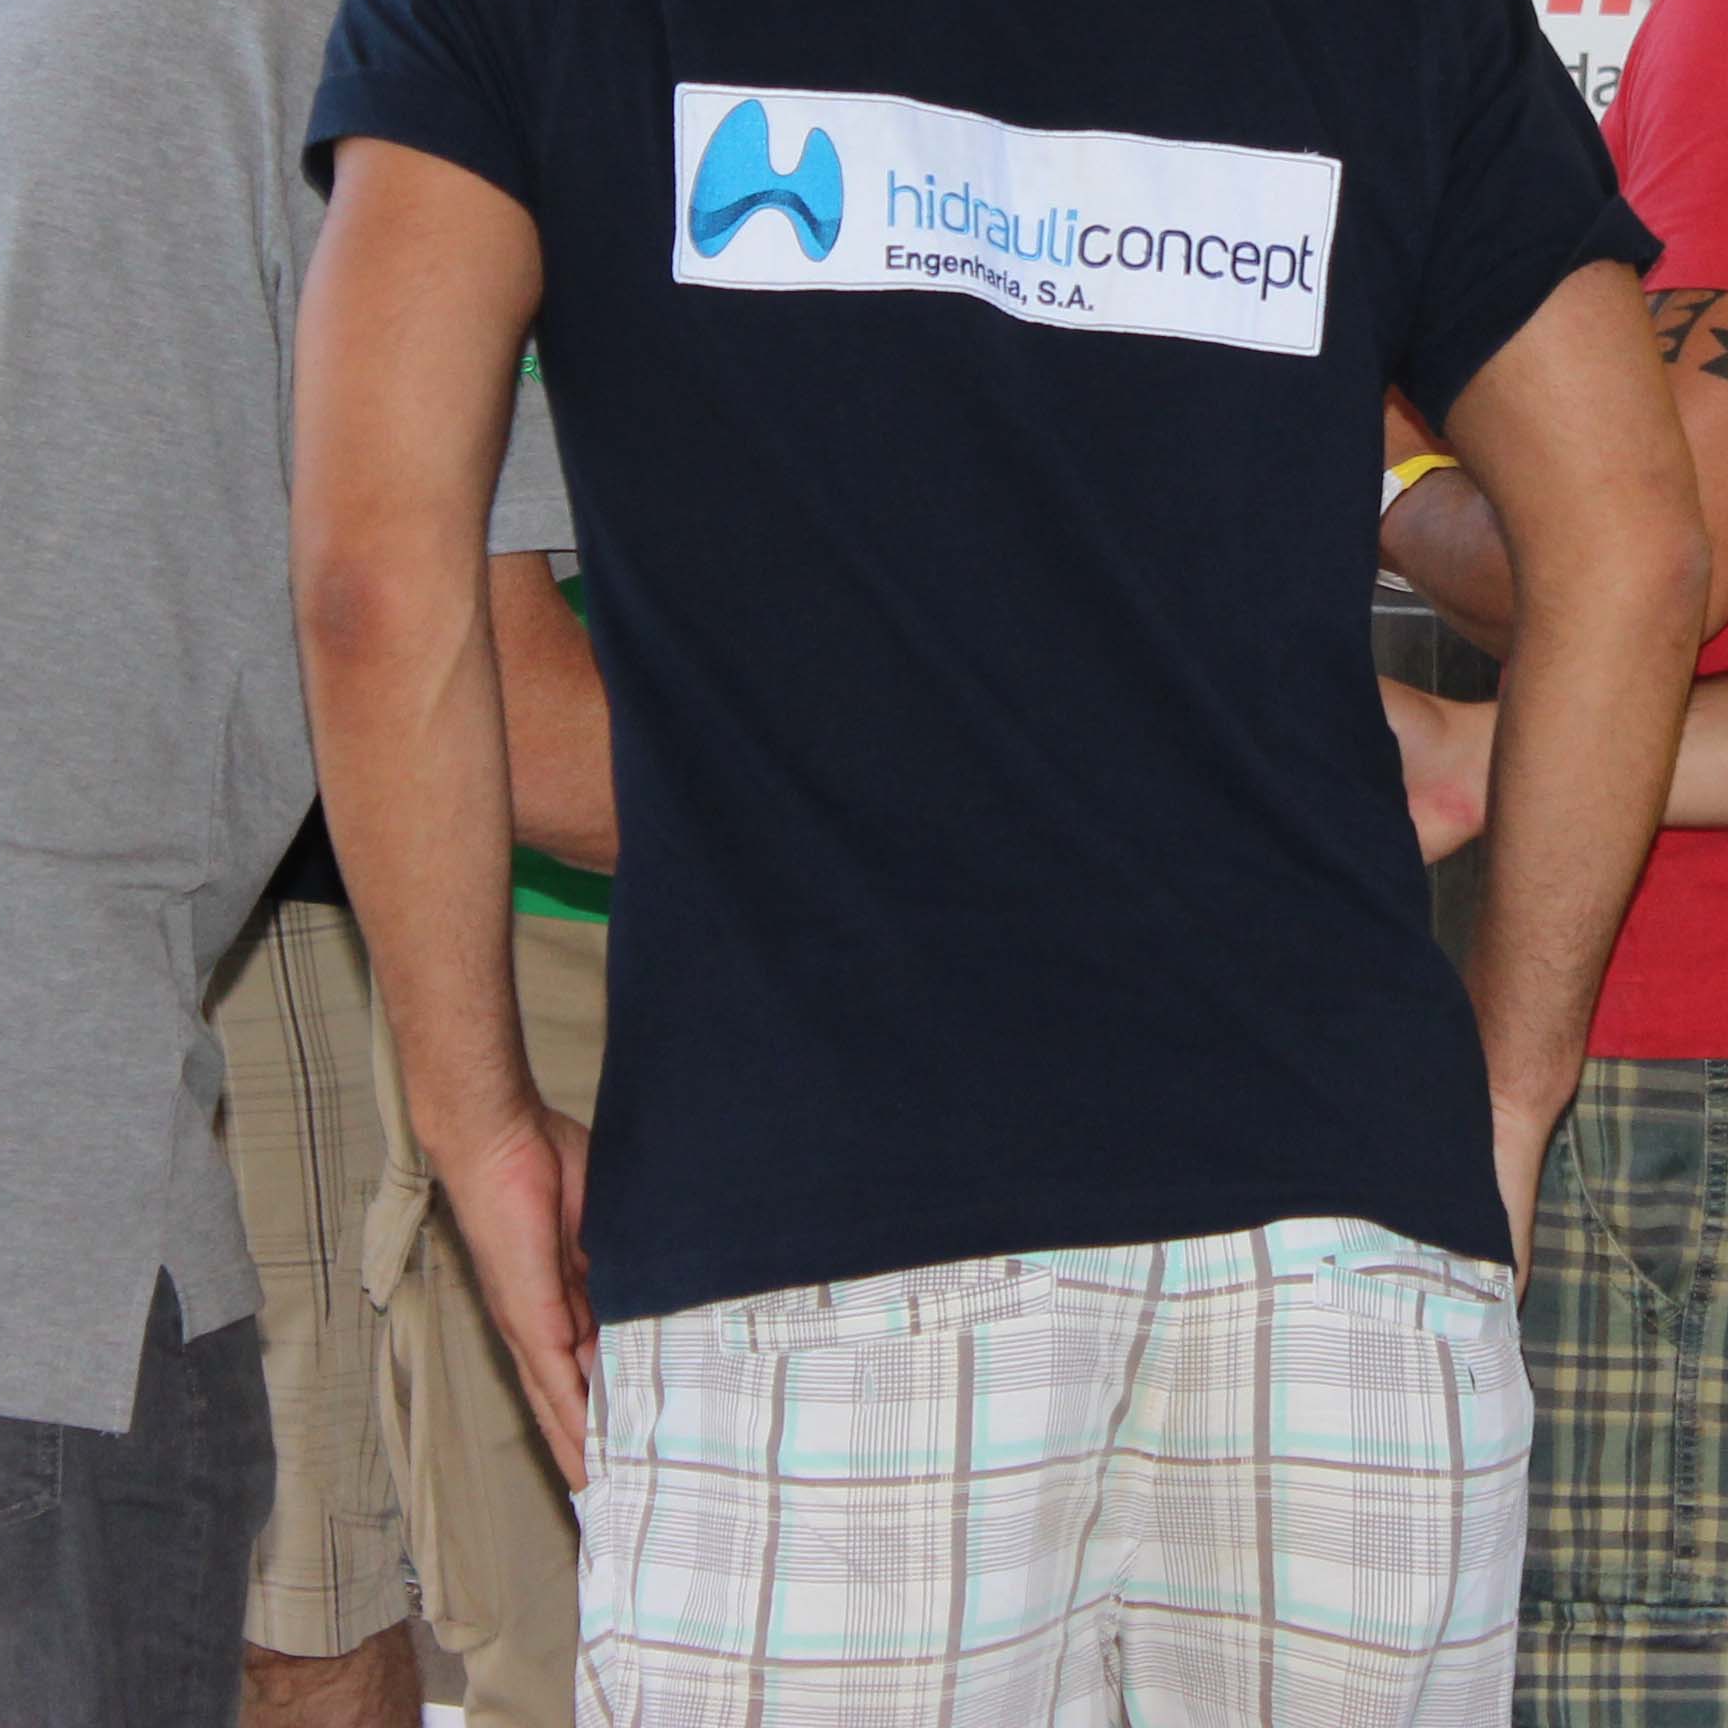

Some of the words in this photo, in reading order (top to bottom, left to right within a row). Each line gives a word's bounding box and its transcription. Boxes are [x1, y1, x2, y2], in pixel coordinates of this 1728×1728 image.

[885, 245, 1029, 305] Engenharia,
[1036, 282, 1094, 313] S.A.
[887, 168, 1315, 301] hidrauliconcept
